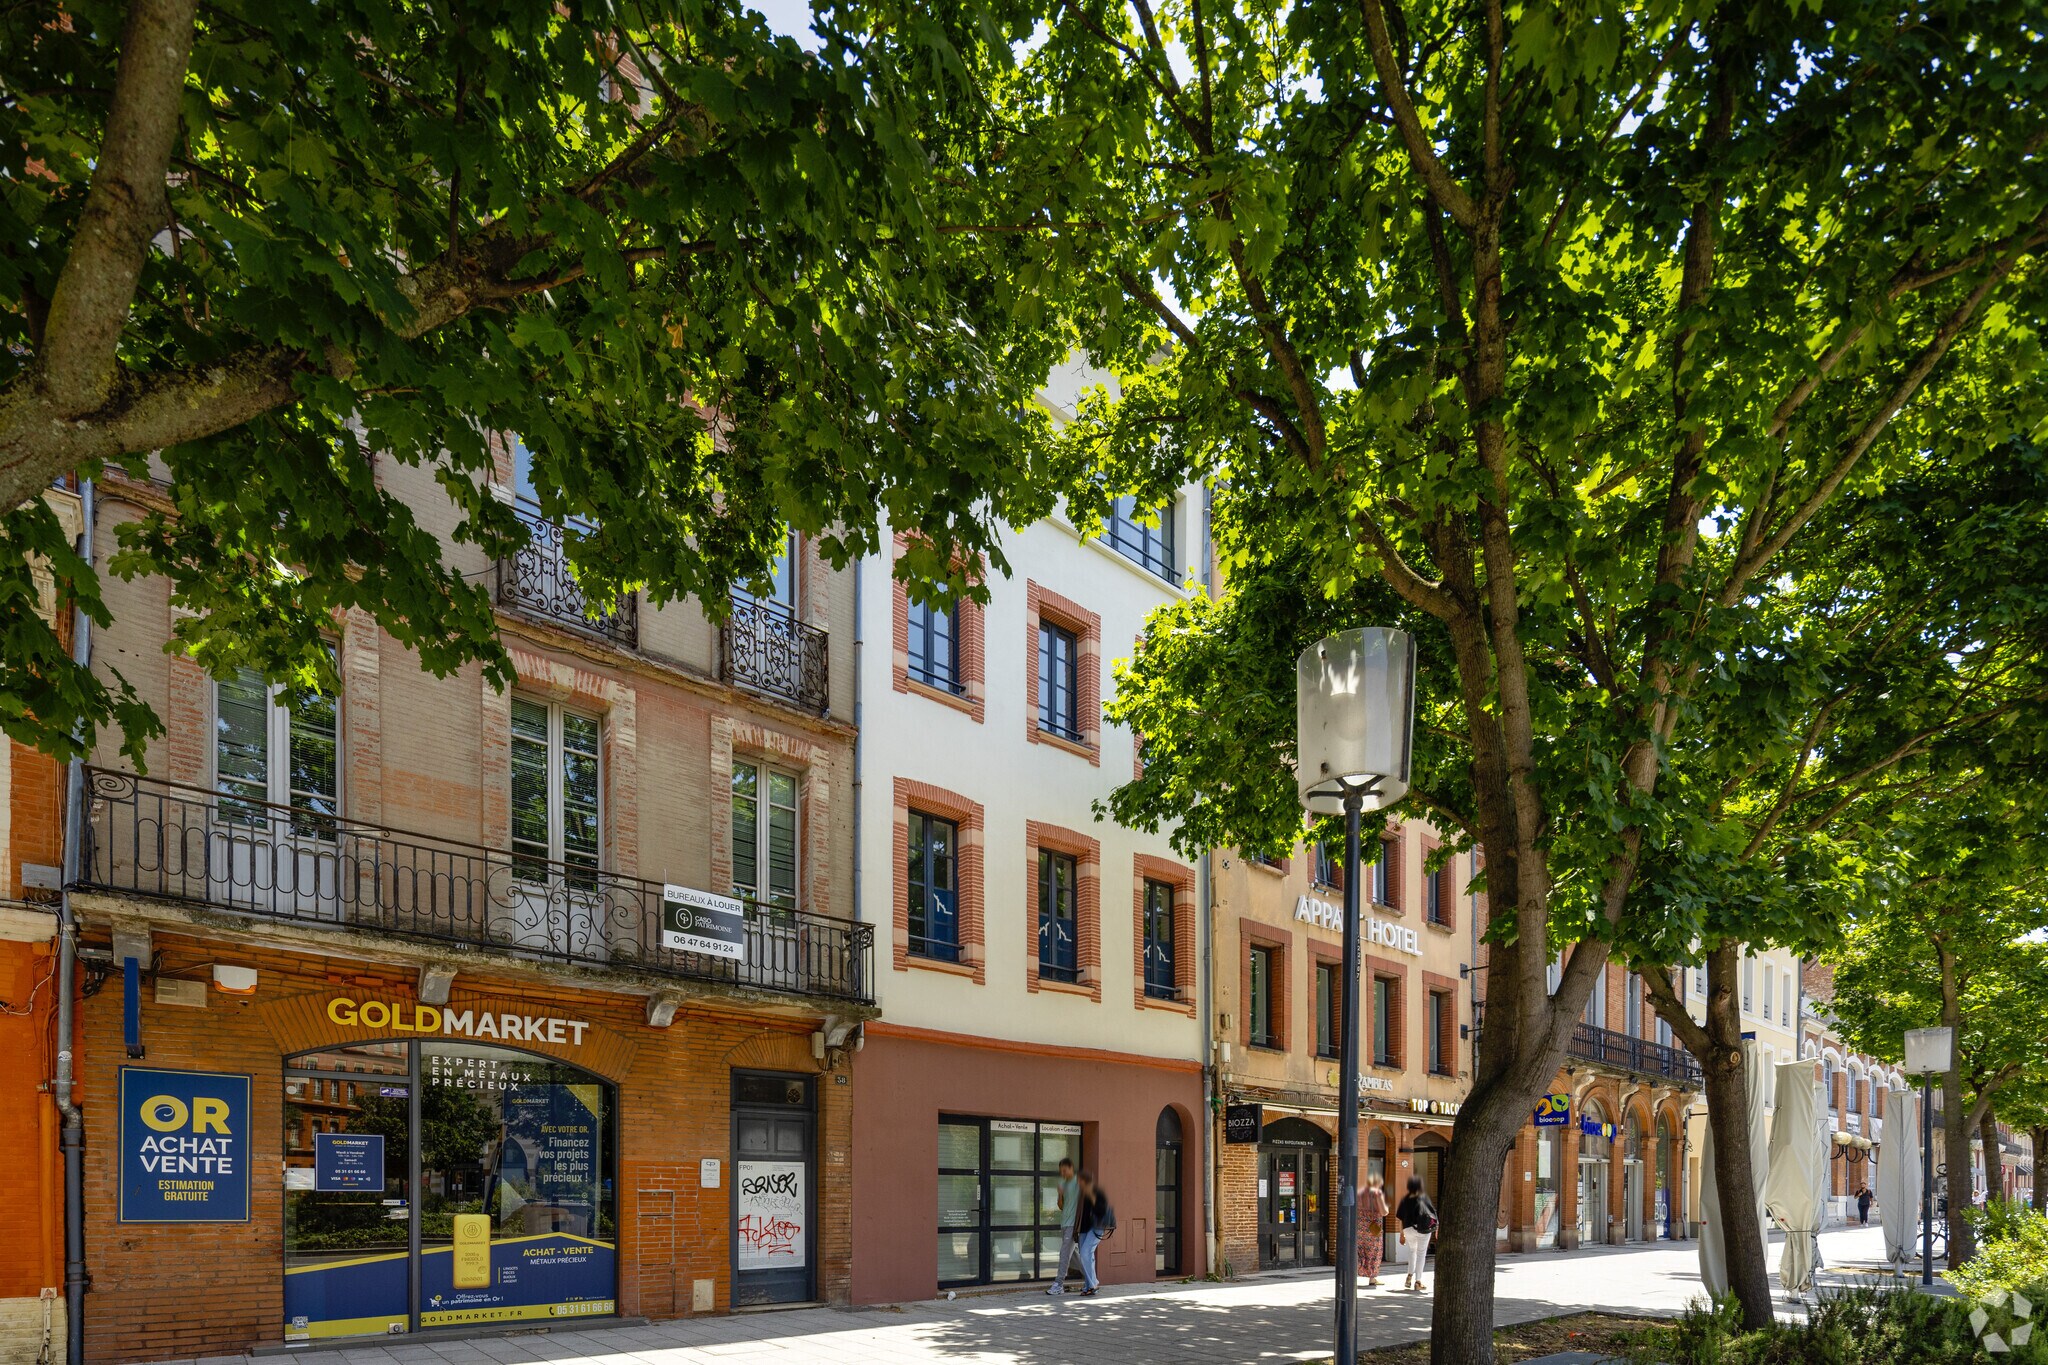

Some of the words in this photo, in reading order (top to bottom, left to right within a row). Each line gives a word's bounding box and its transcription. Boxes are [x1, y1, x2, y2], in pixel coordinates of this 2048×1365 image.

[668, 890, 705, 904] BUREAUX
[714, 900, 740, 912] LOUER
[695, 922, 732, 933] PATRIMOINE
[674, 936, 685, 944] 06
[1368, 917, 1422, 956] HOTEL
[327, 998, 589, 1045] GOLDMARKET
[432, 1056, 498, 1069] EXPERT
[432, 1067, 453, 1076] EN
[465, 1067, 531, 1082] MÉTAUX
[432, 1077, 518, 1091] PRÉCIEUX
[1412, 1098, 1428, 1112] TOP
[1440, 1102, 1462, 1115] TACO
[140, 1095, 232, 1134] OR
[1228, 1118, 1255, 1127] BIOZZA
[140, 1136, 232, 1154] ACHAT
[549, 1137, 589, 1147] Financez
[557, 1149, 589, 1161] projets
[140, 1155, 232, 1174] VENTE
[554, 1161, 567, 1170] les
[570, 1161, 589, 1172] plus
[543, 1172, 582, 1184] précieux
[158, 1180, 214, 1190] ESTIMATION
[164, 1192, 208, 1201] GRATUITE
[523, 1247, 554, 1256] ACHAT
[563, 1246, 593, 1255] VENTE
[557, 1306, 567, 1315] 05
[570, 1304, 579, 1314] 31
[581, 1304, 590, 1313] 61
[592, 1303, 602, 1312] 66
[604, 1302, 614, 1311] 66
[421, 1310, 523, 1322] GOLDMARKET.FR
